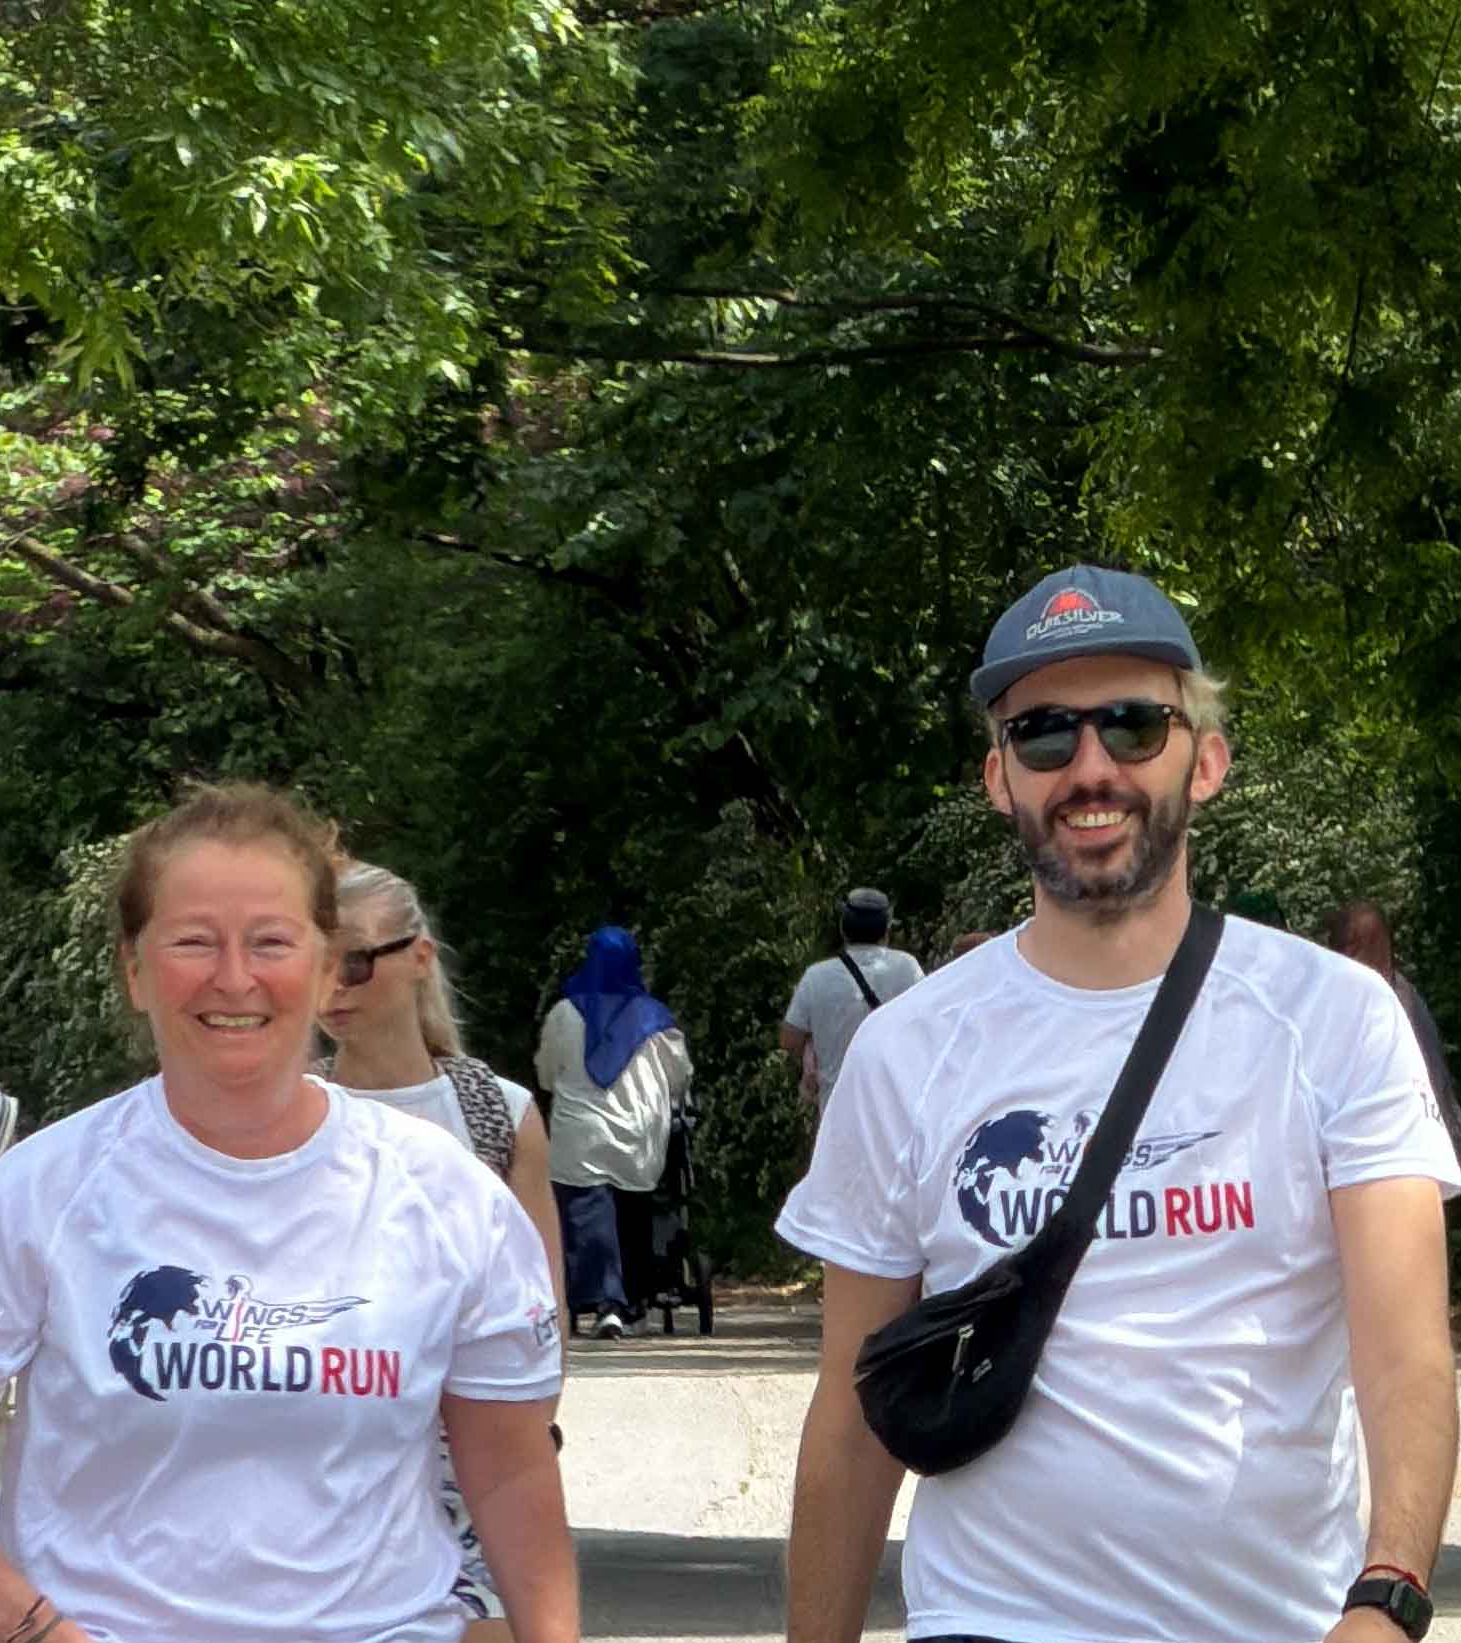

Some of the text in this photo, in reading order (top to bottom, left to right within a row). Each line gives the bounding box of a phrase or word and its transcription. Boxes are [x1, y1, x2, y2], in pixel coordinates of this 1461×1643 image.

[999, 1181, 1255, 1240] WOLD RUN
[201, 1298, 309, 1327] WINGS
[213, 1321, 278, 1345] LIFE
[154, 1342, 401, 1399] WORLD RUN
